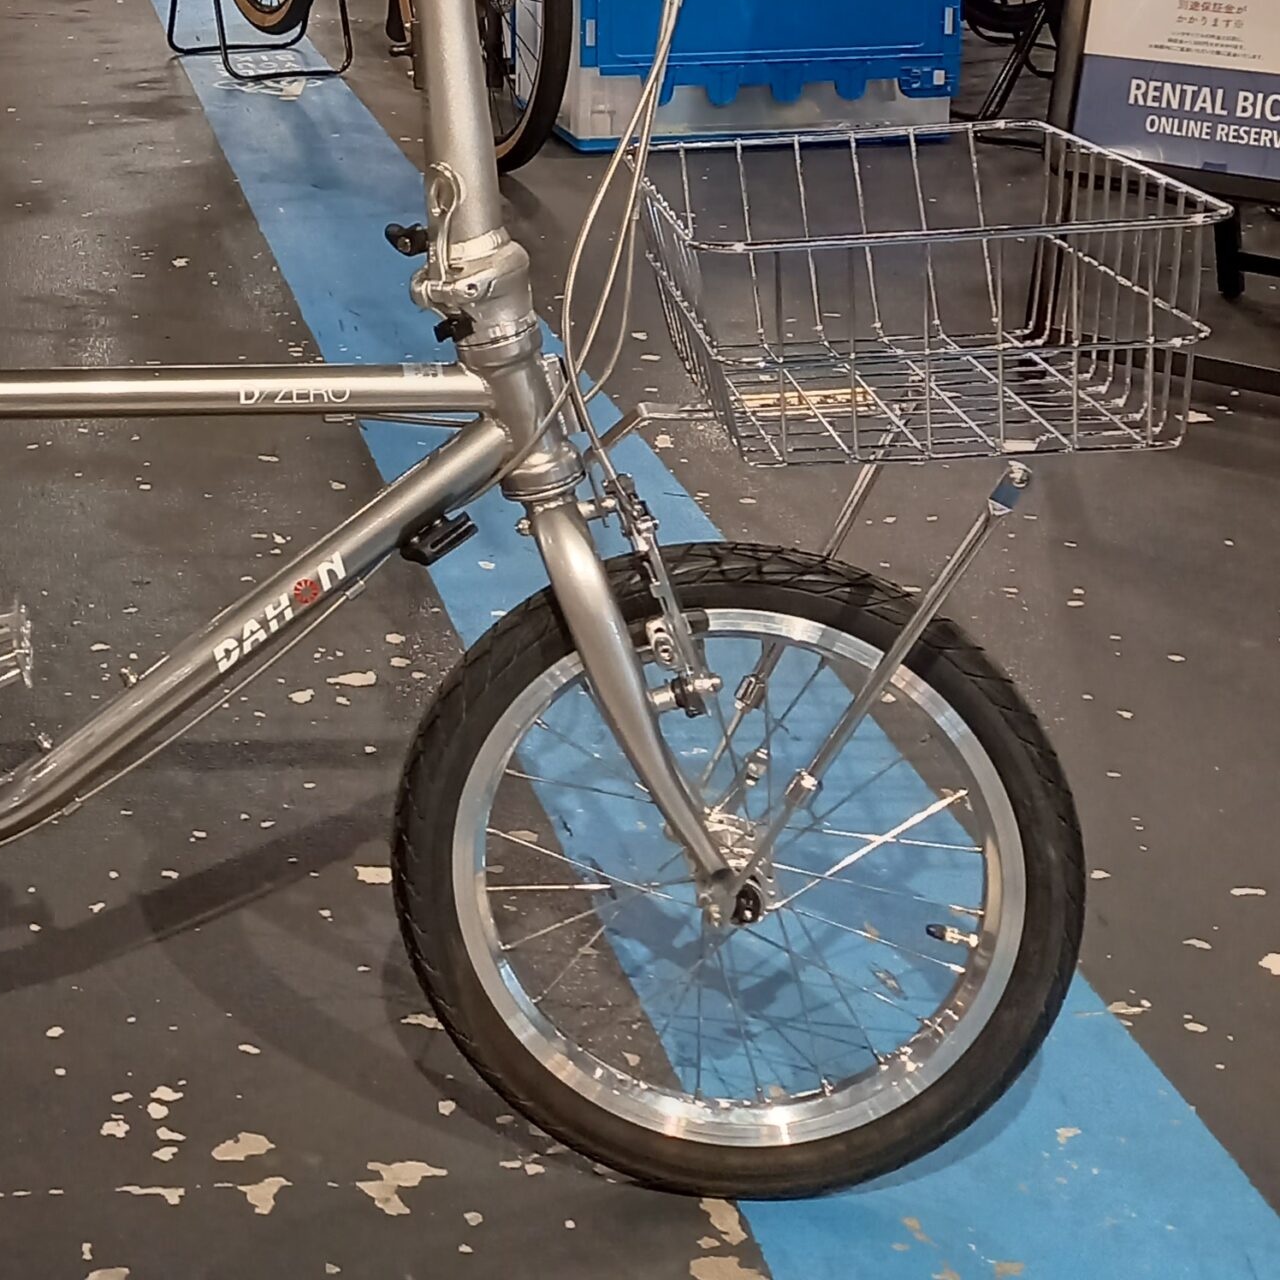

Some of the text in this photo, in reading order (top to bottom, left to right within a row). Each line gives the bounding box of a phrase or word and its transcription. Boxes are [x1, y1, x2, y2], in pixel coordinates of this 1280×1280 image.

[1128, 78, 1228, 116] RENTAL
[1145, 114, 1213, 140] ONLINE
[212, 550, 347, 673] DAHON
